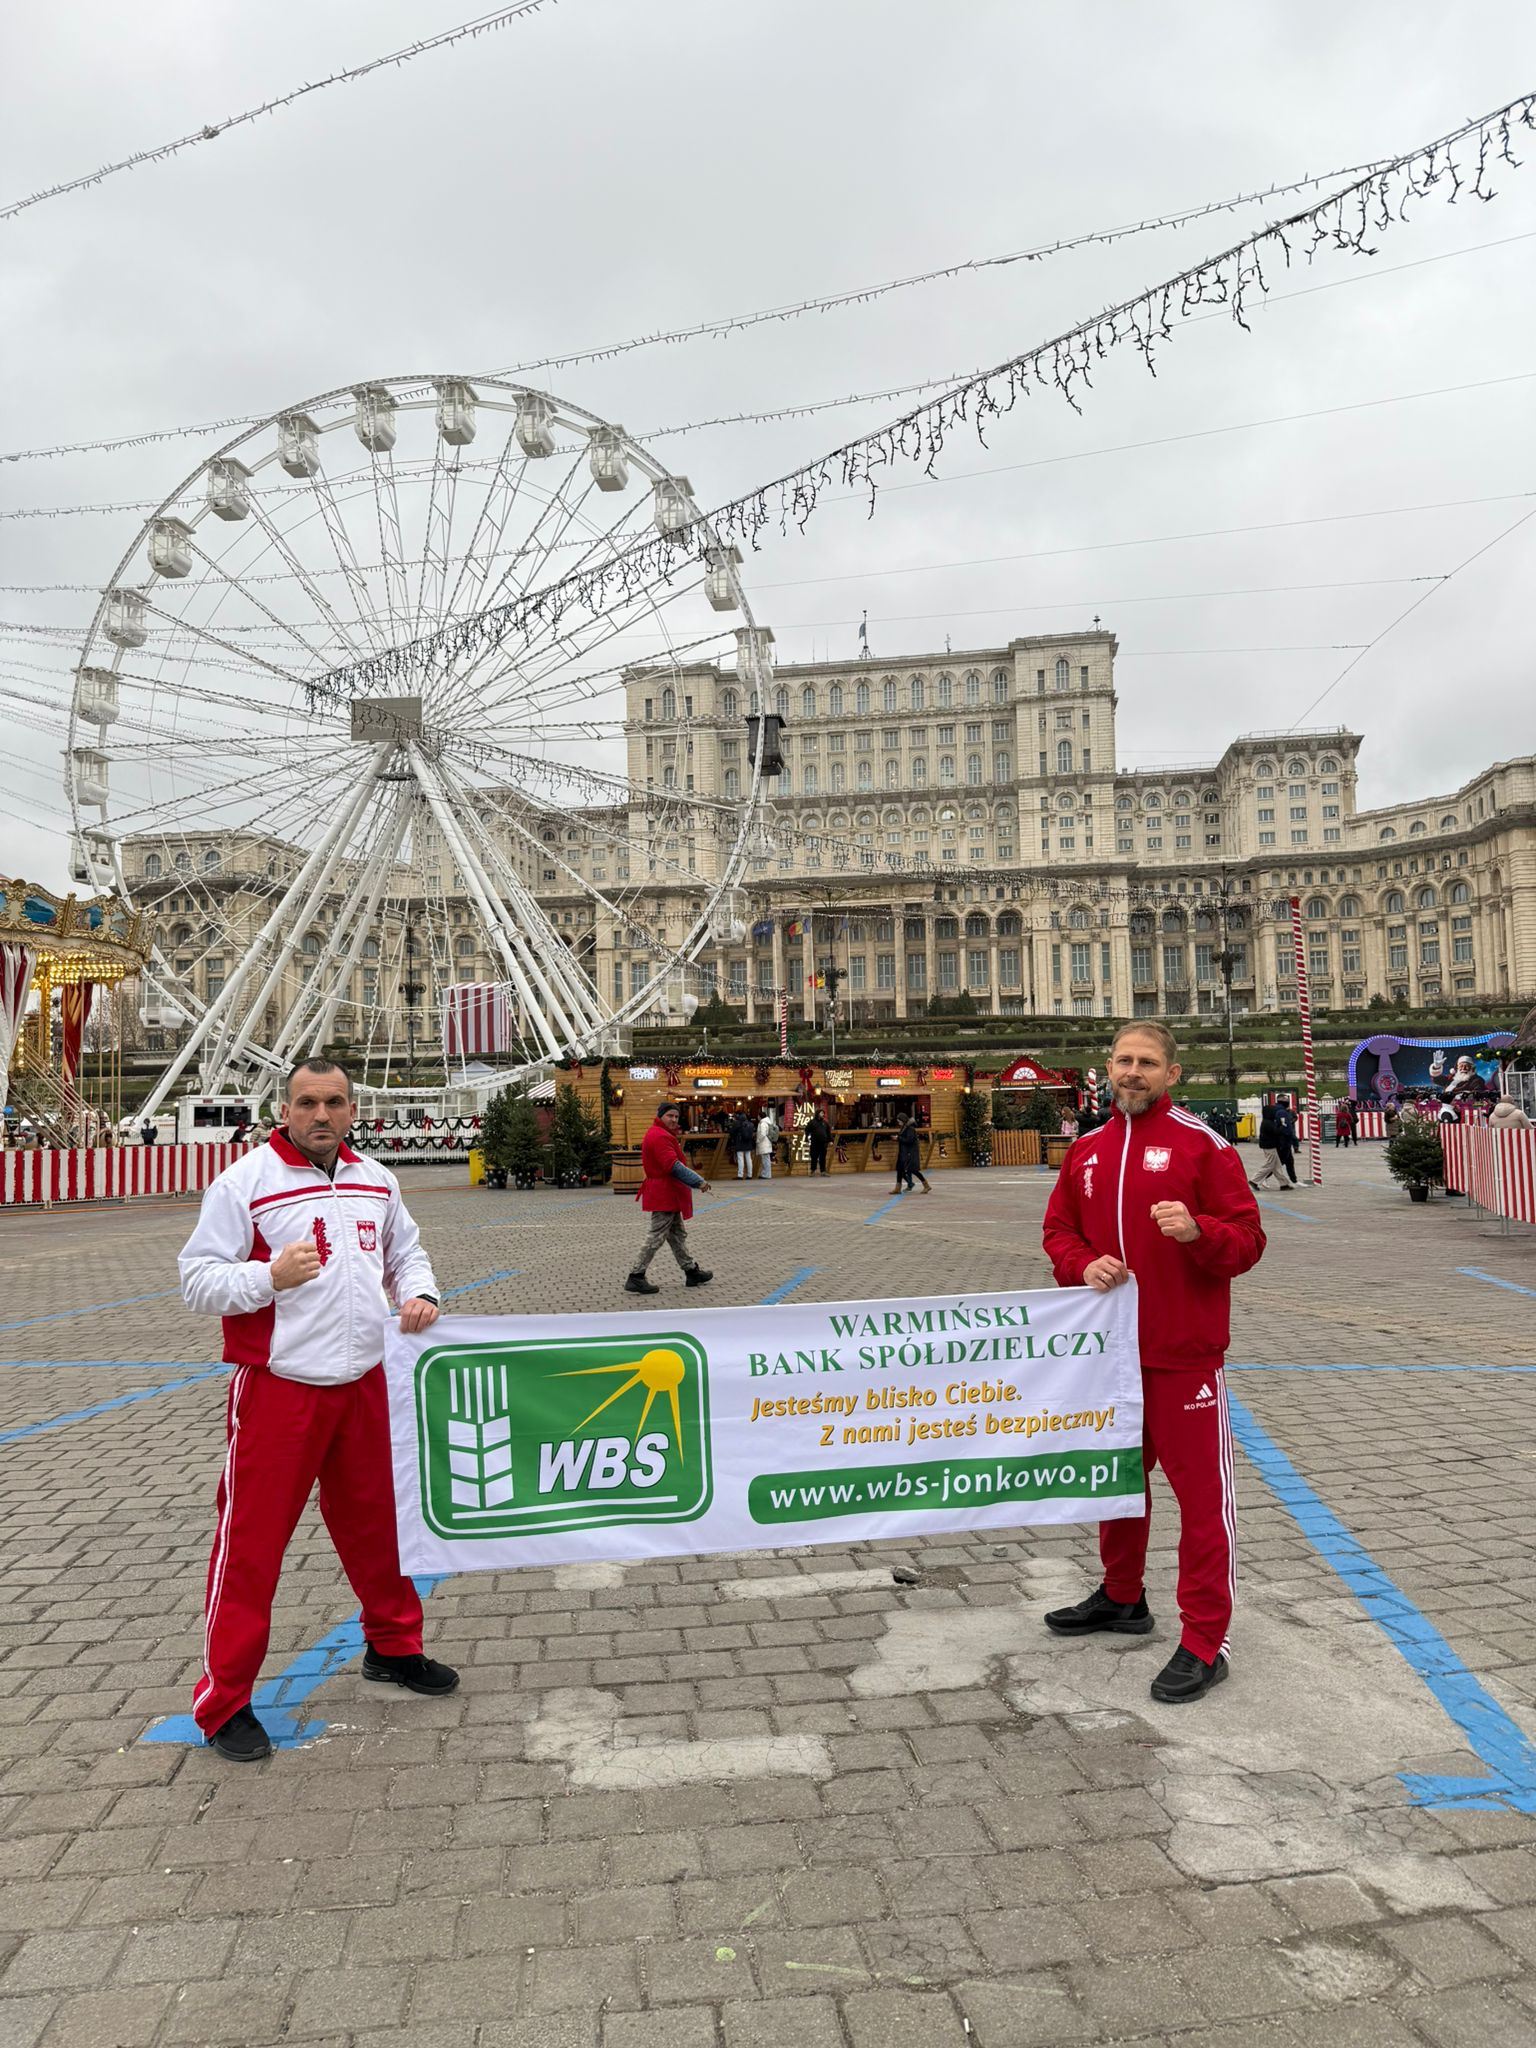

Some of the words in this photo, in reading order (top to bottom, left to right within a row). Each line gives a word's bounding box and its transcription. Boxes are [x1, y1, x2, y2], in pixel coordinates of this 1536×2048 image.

[796, 1101, 815, 1114] VIN
[829, 1302, 1031, 1339] WARMIŃSKI
[749, 1348, 844, 1377] BANK
[858, 1331, 1111, 1370] SPÓŁDZIELCZY
[751, 1391, 858, 1422] Jesteśmy
[866, 1385, 937, 1410] blisko
[945, 1379, 1022, 1404] Ciebie.
[819, 1424, 835, 1446] Z
[843, 1417, 901, 1444] nami
[907, 1413, 977, 1446] jesteś
[985, 1406, 1116, 1438] bezpieczny!
[538, 1432, 670, 1494] WBS
[770, 1456, 1119, 1509] www.wbs-jonkowo.pl
